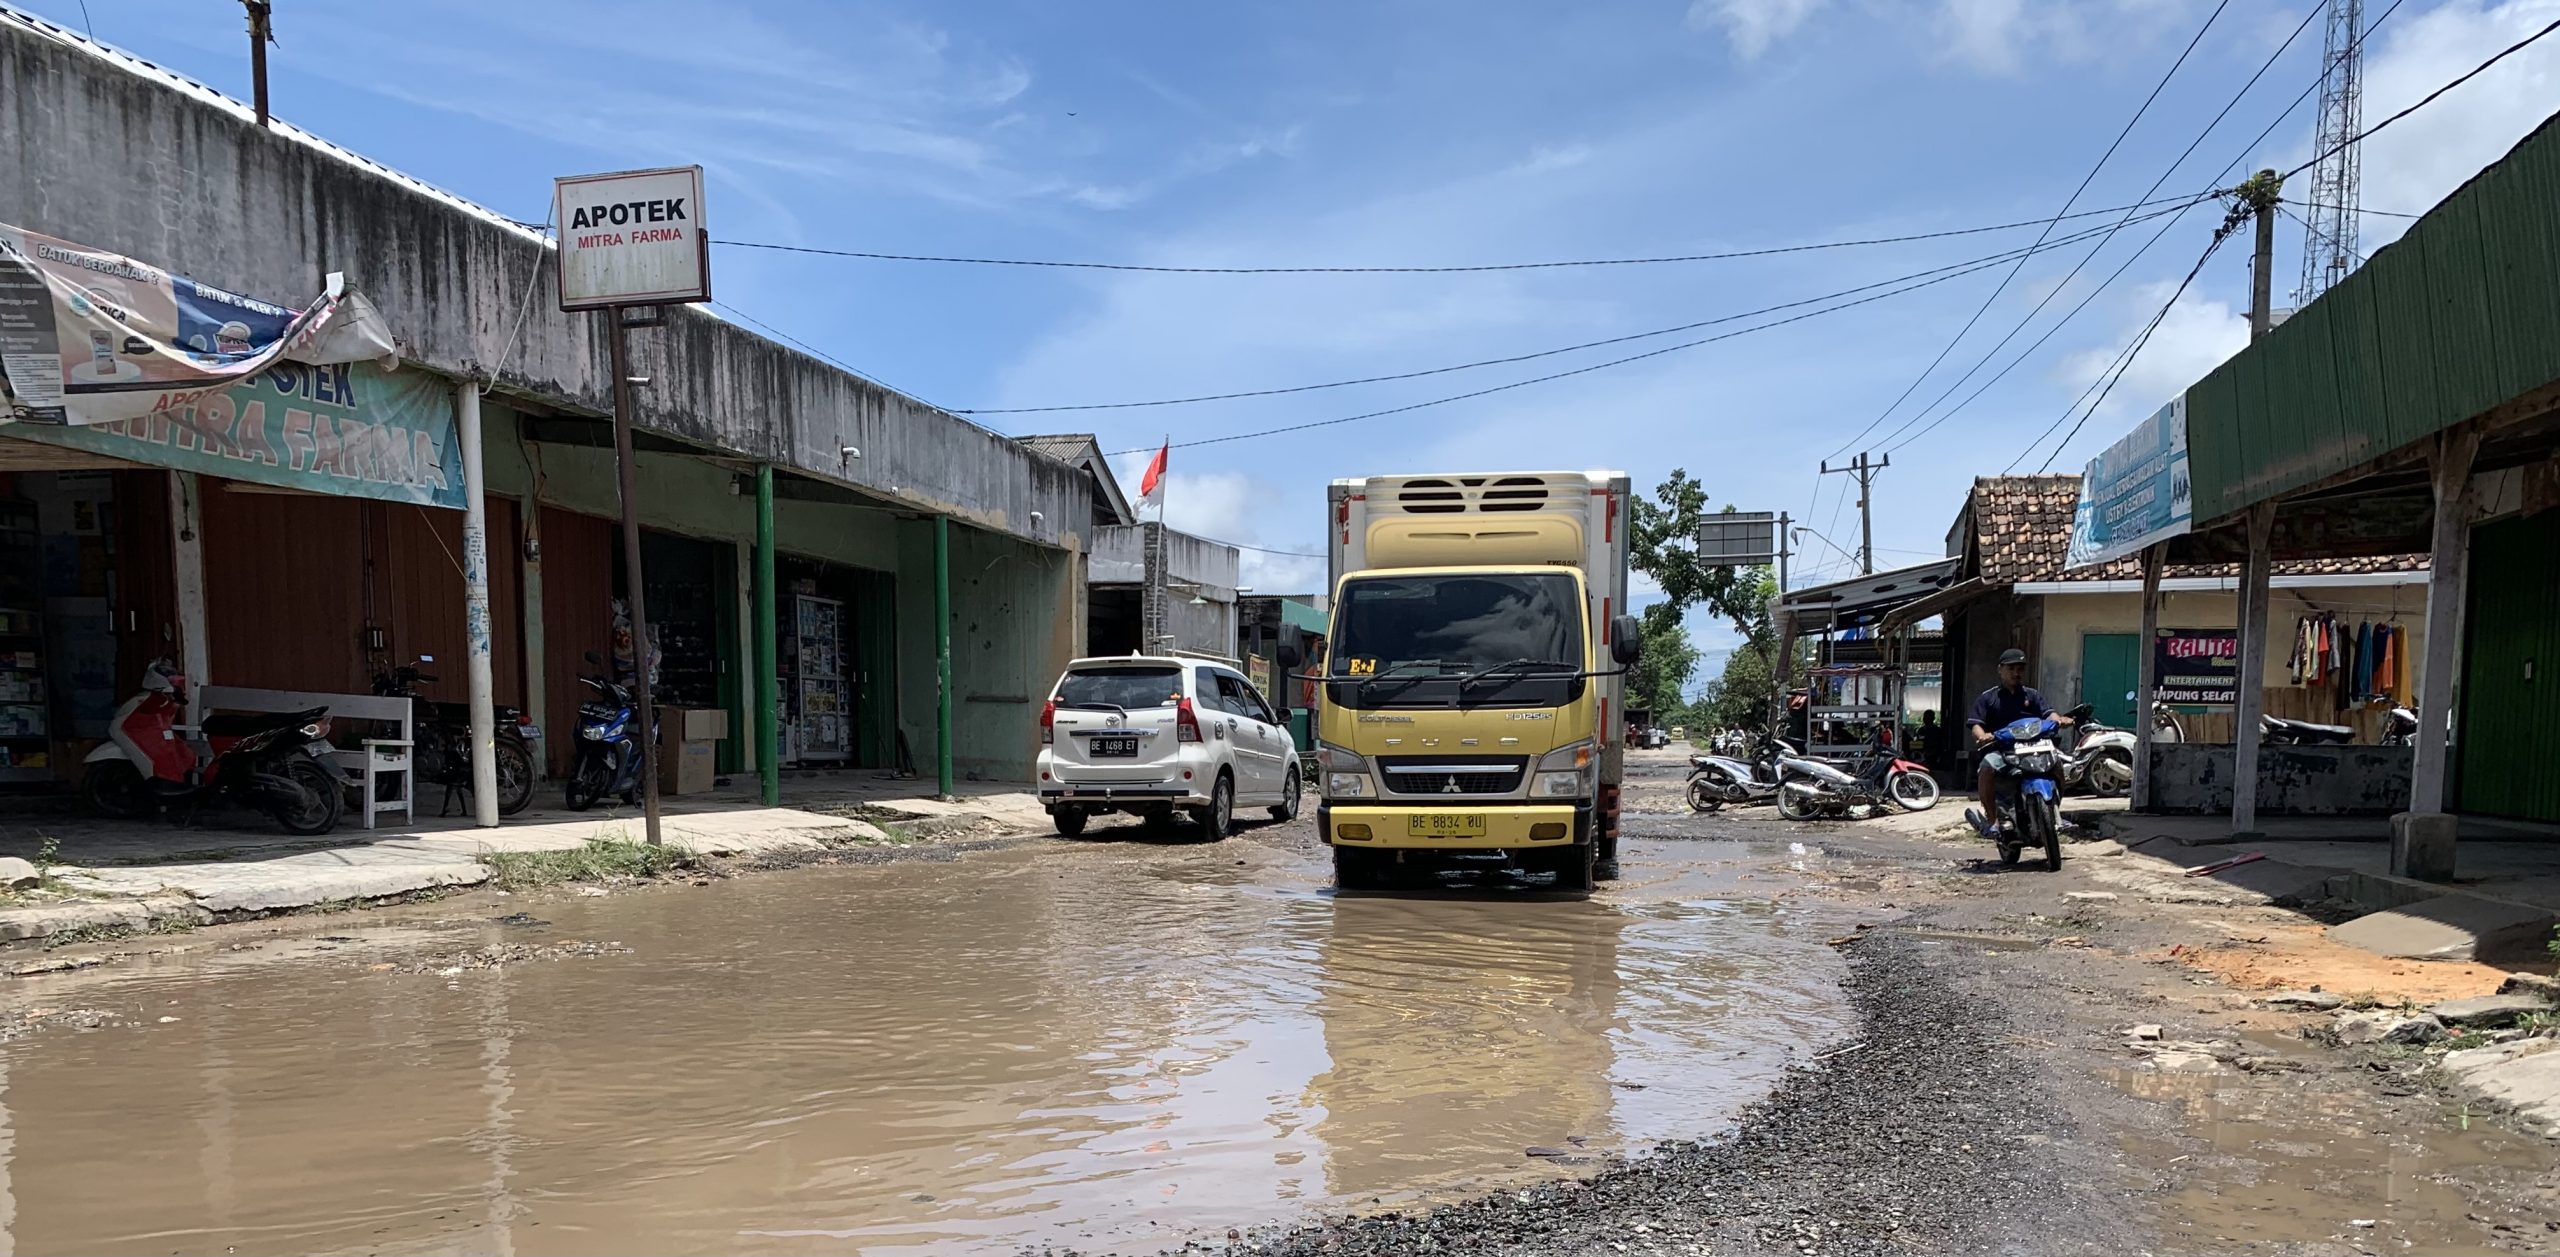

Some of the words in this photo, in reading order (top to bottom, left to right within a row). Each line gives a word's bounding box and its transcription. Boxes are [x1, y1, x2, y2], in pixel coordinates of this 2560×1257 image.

[571, 198, 687, 229] APOTEK
[578, 233, 623, 249] MITRA
[631, 227, 683, 244] FARMA
[37, 243, 81, 266] BATUK
[83, 256, 150, 283] BERDAHAK
[194, 284, 234, 304] BATUK
[243, 298, 273, 316] PILEK
[283, 407, 449, 490] FARMA
[2167, 637, 2237, 657] RALITA
[2163, 676, 2235, 686] ENTERTAINMENT
[1091, 740, 1101, 751] BE
[1126, 739, 1136, 750] ET
[1385, 737, 1520, 747] FUSO
[1412, 815, 1426, 828] BE
[1433, 815, 1460, 829] 8834
